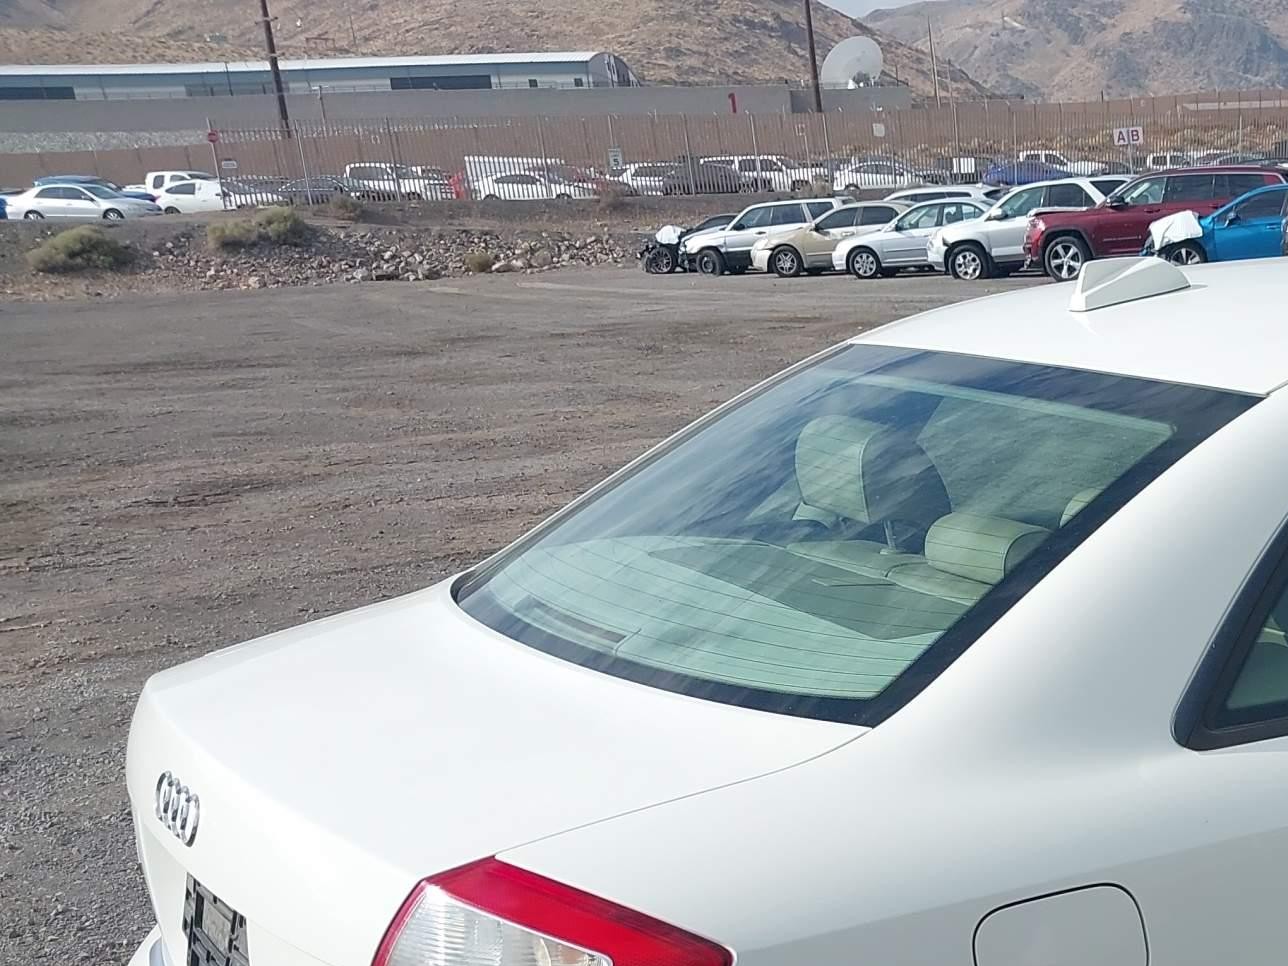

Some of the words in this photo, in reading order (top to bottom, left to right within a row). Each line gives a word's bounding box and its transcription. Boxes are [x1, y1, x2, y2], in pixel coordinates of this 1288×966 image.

[1116, 127, 1127, 143] A
[1131, 127, 1140, 143] B
[613, 158, 620, 166] 5
